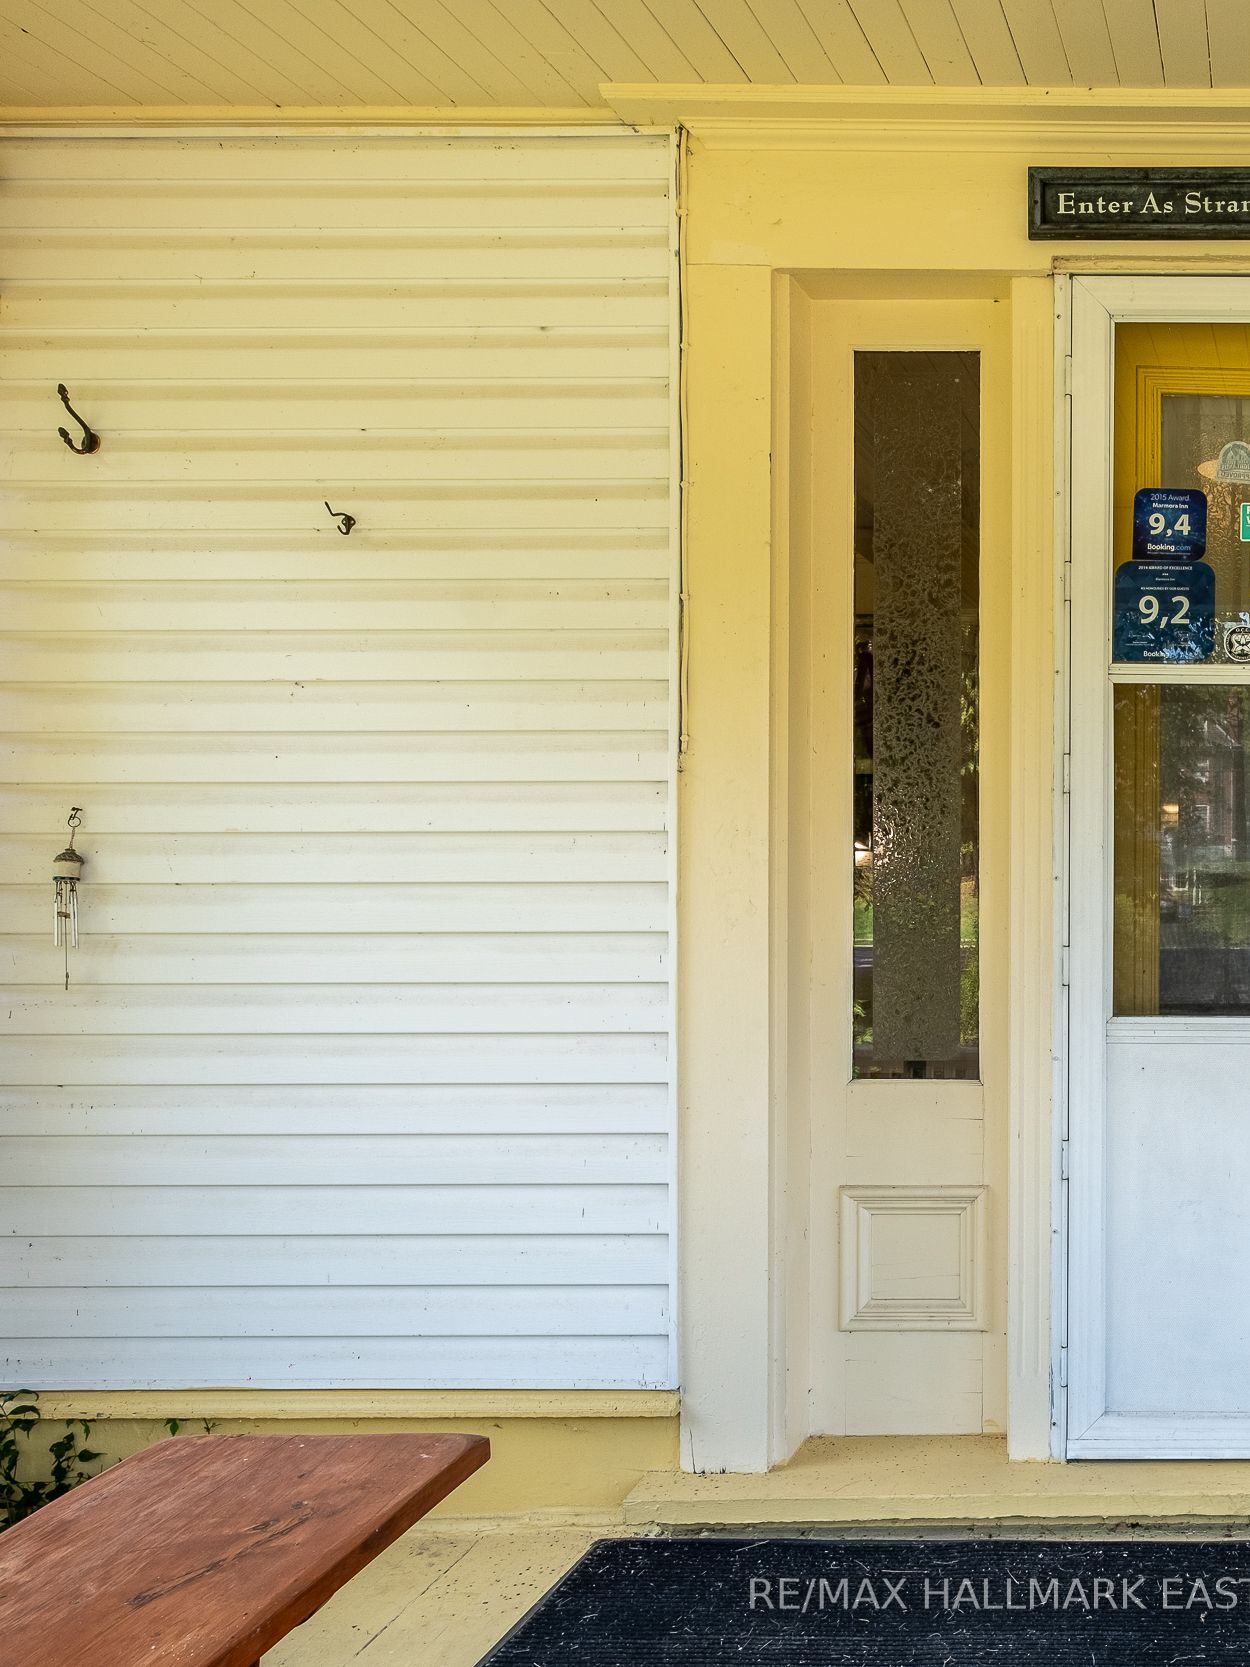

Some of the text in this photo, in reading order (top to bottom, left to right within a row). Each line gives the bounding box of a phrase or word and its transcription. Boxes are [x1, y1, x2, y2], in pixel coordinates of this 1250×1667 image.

[1057, 191, 1133, 214] Enter
[1141, 191, 1174, 214] As
[1168, 494, 1190, 502] Award
[1148, 513, 1191, 537] 9,4
[1147, 543, 1191, 552] Booking.com
[1138, 595, 1190, 629] 9,2
